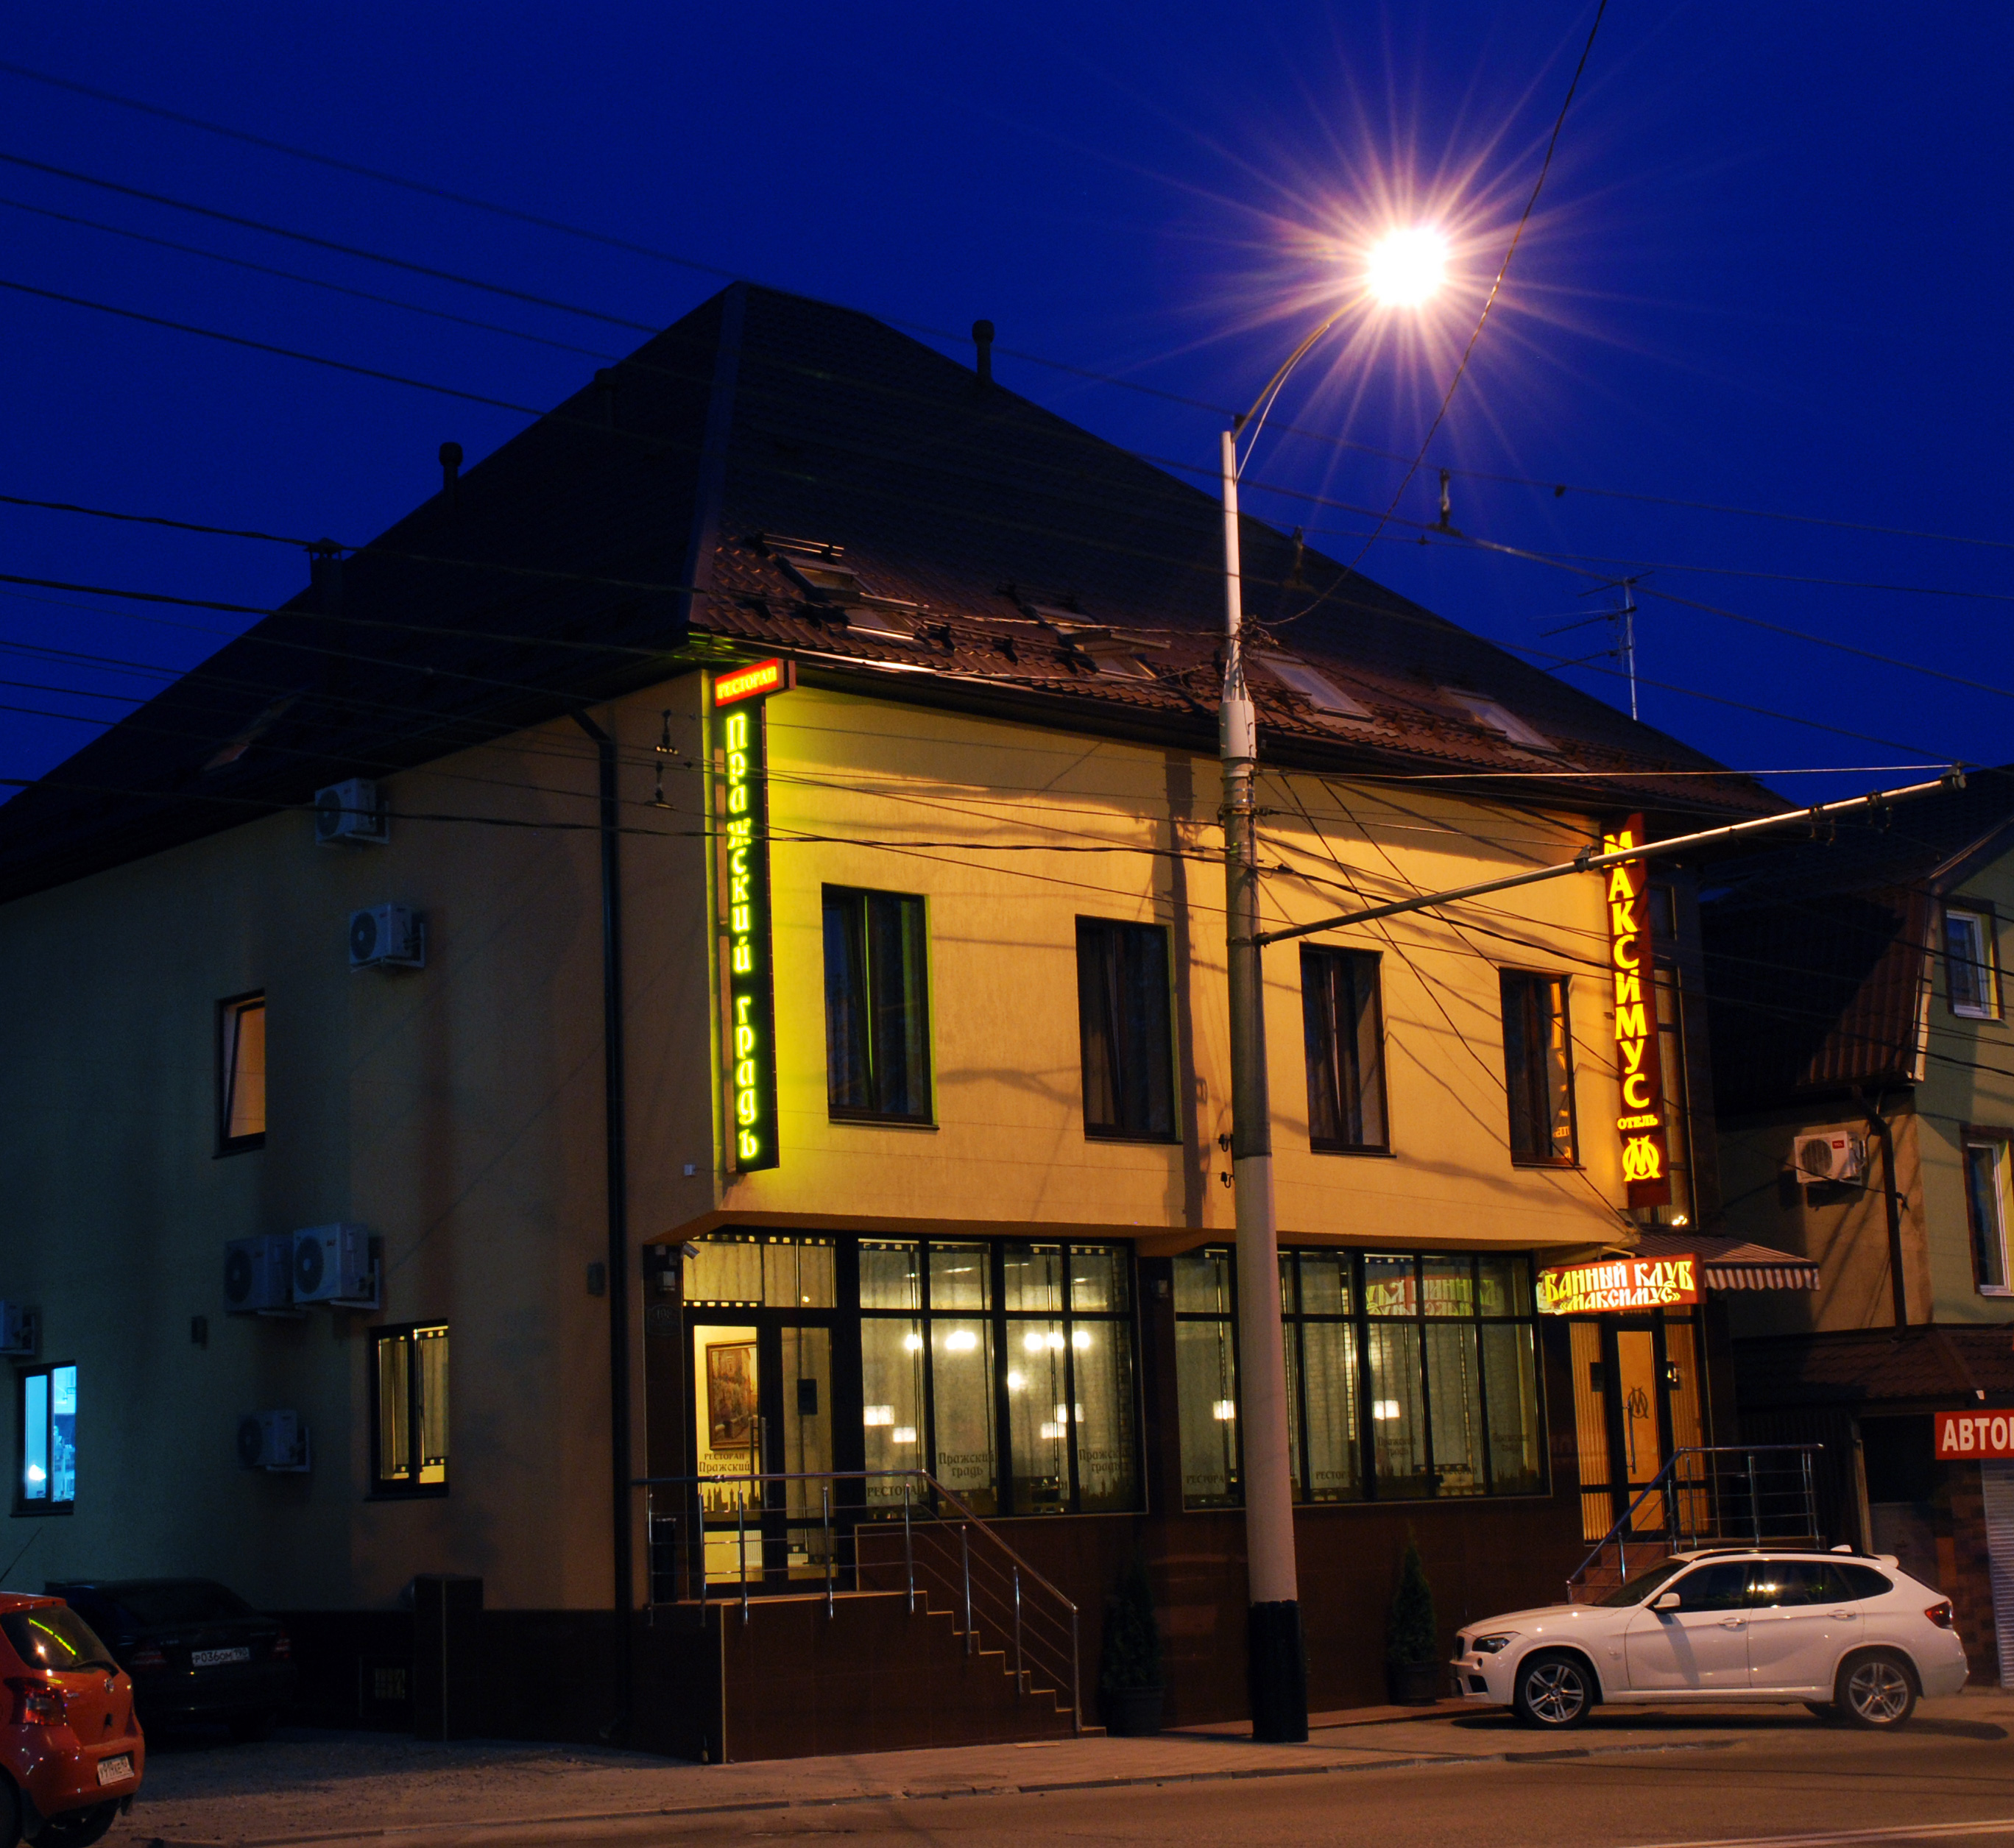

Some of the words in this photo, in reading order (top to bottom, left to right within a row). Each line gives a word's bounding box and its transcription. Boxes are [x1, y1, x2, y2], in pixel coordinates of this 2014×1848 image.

[717, 666, 777, 699] РЕСТОРАН
[727, 712, 751, 972] Пражский
[1603, 830, 1650, 1108] МАКСИМУС
[1616, 1114, 1658, 1130] ОТЕЛЬ
[1544, 1261, 1628, 1303] БАННЫЙ
[1634, 1261, 1695, 1291] КЛУБ
[1559, 1286, 1681, 1311] «МАКСИМУС»
[699, 1461, 751, 1474] Пражский
